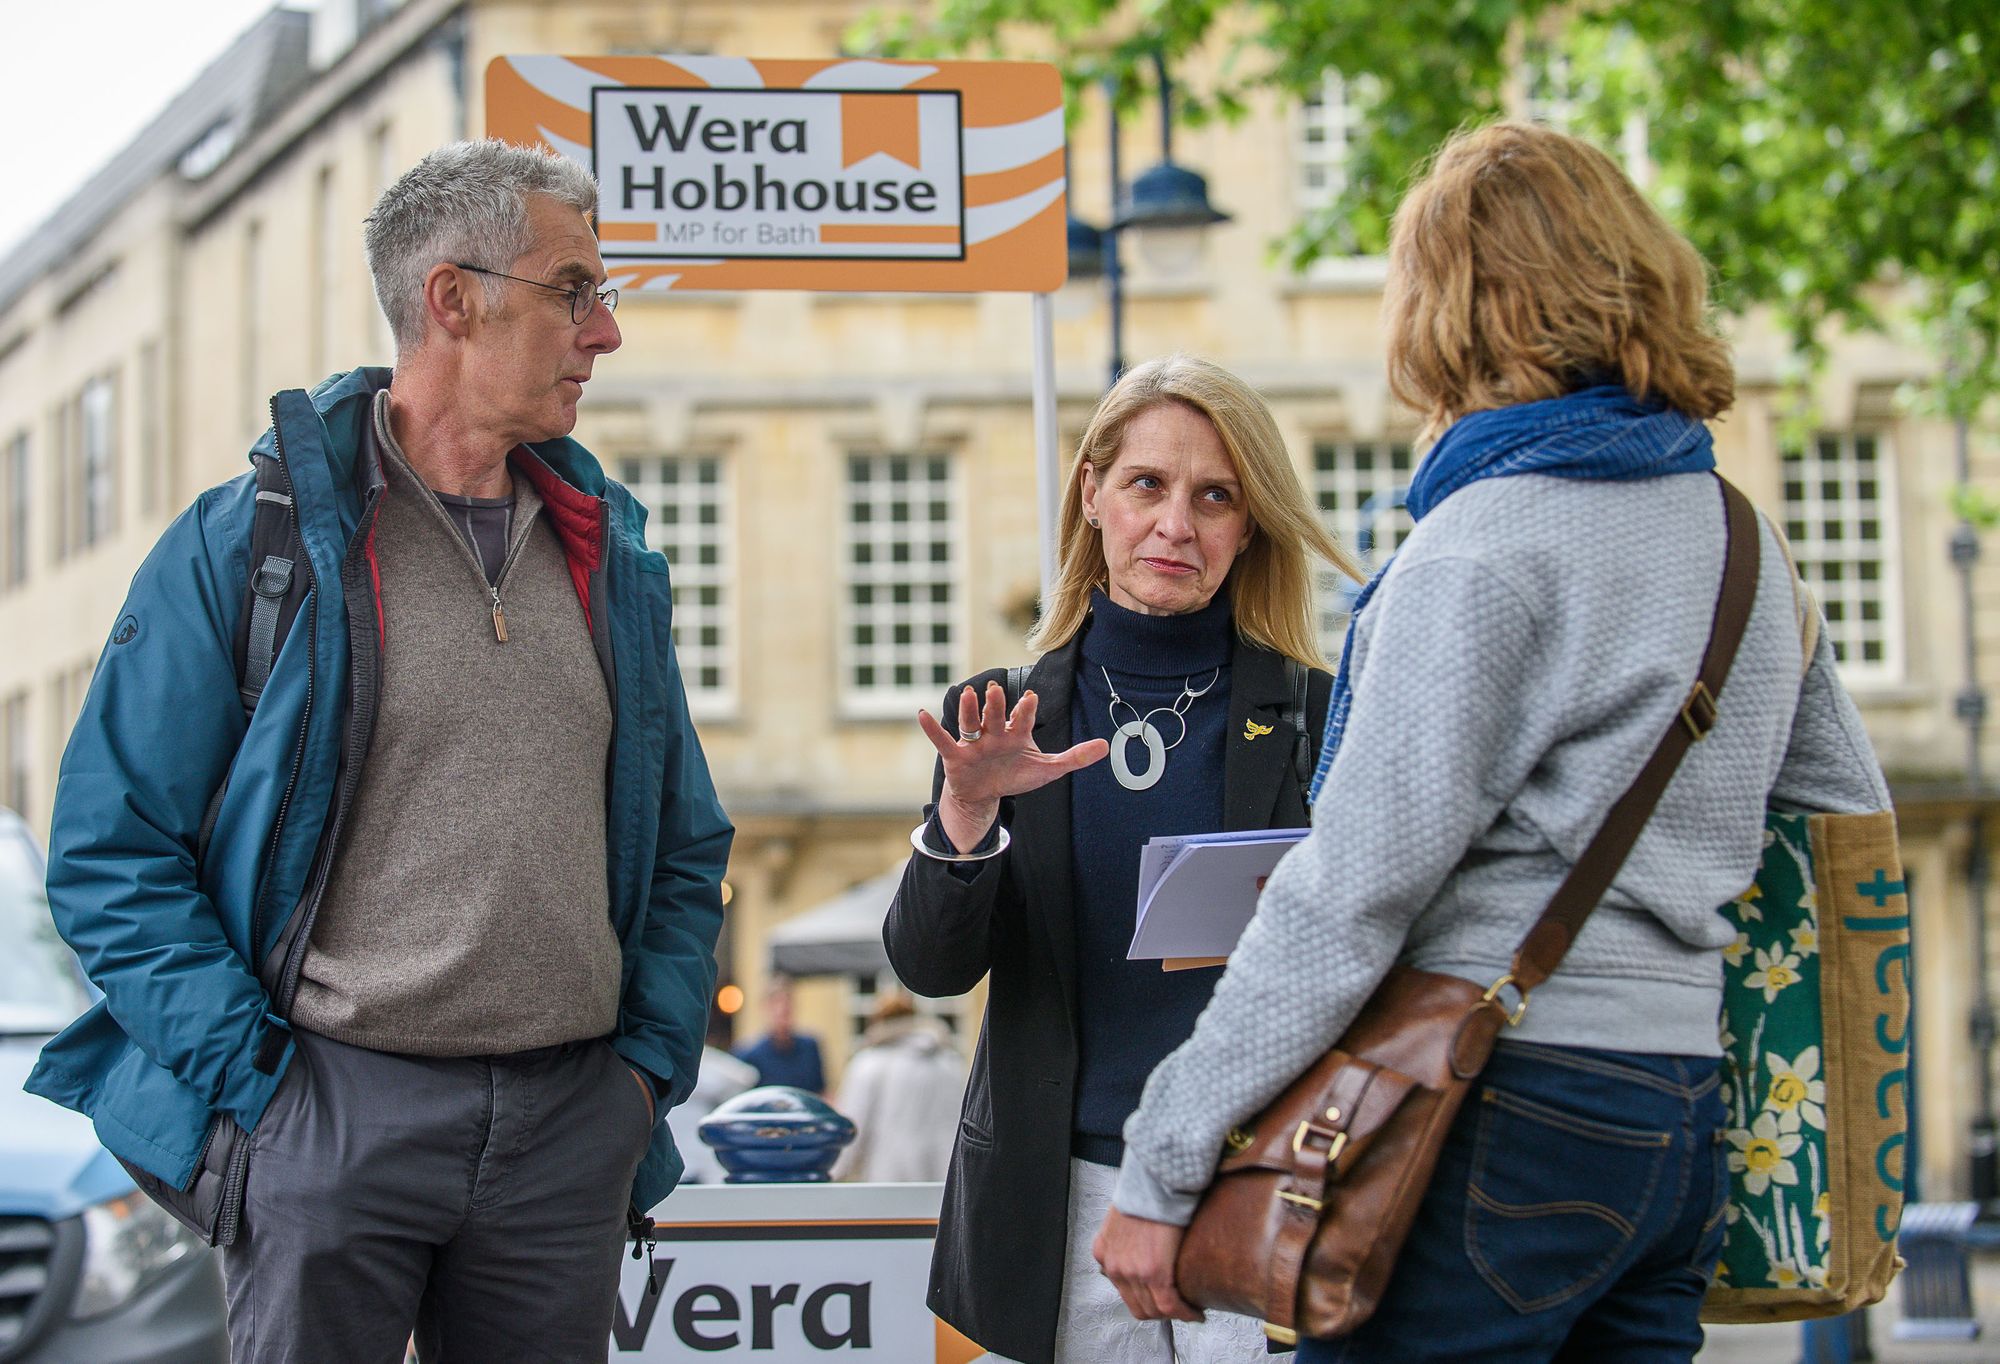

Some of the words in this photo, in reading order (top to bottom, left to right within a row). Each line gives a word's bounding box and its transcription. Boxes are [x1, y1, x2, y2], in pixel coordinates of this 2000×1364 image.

[624, 104, 807, 154] Wera
[620, 163, 937, 213] Hobhouse
[663, 222, 705, 243] MP
[712, 221, 748, 244] for
[757, 222, 816, 246] Bath
